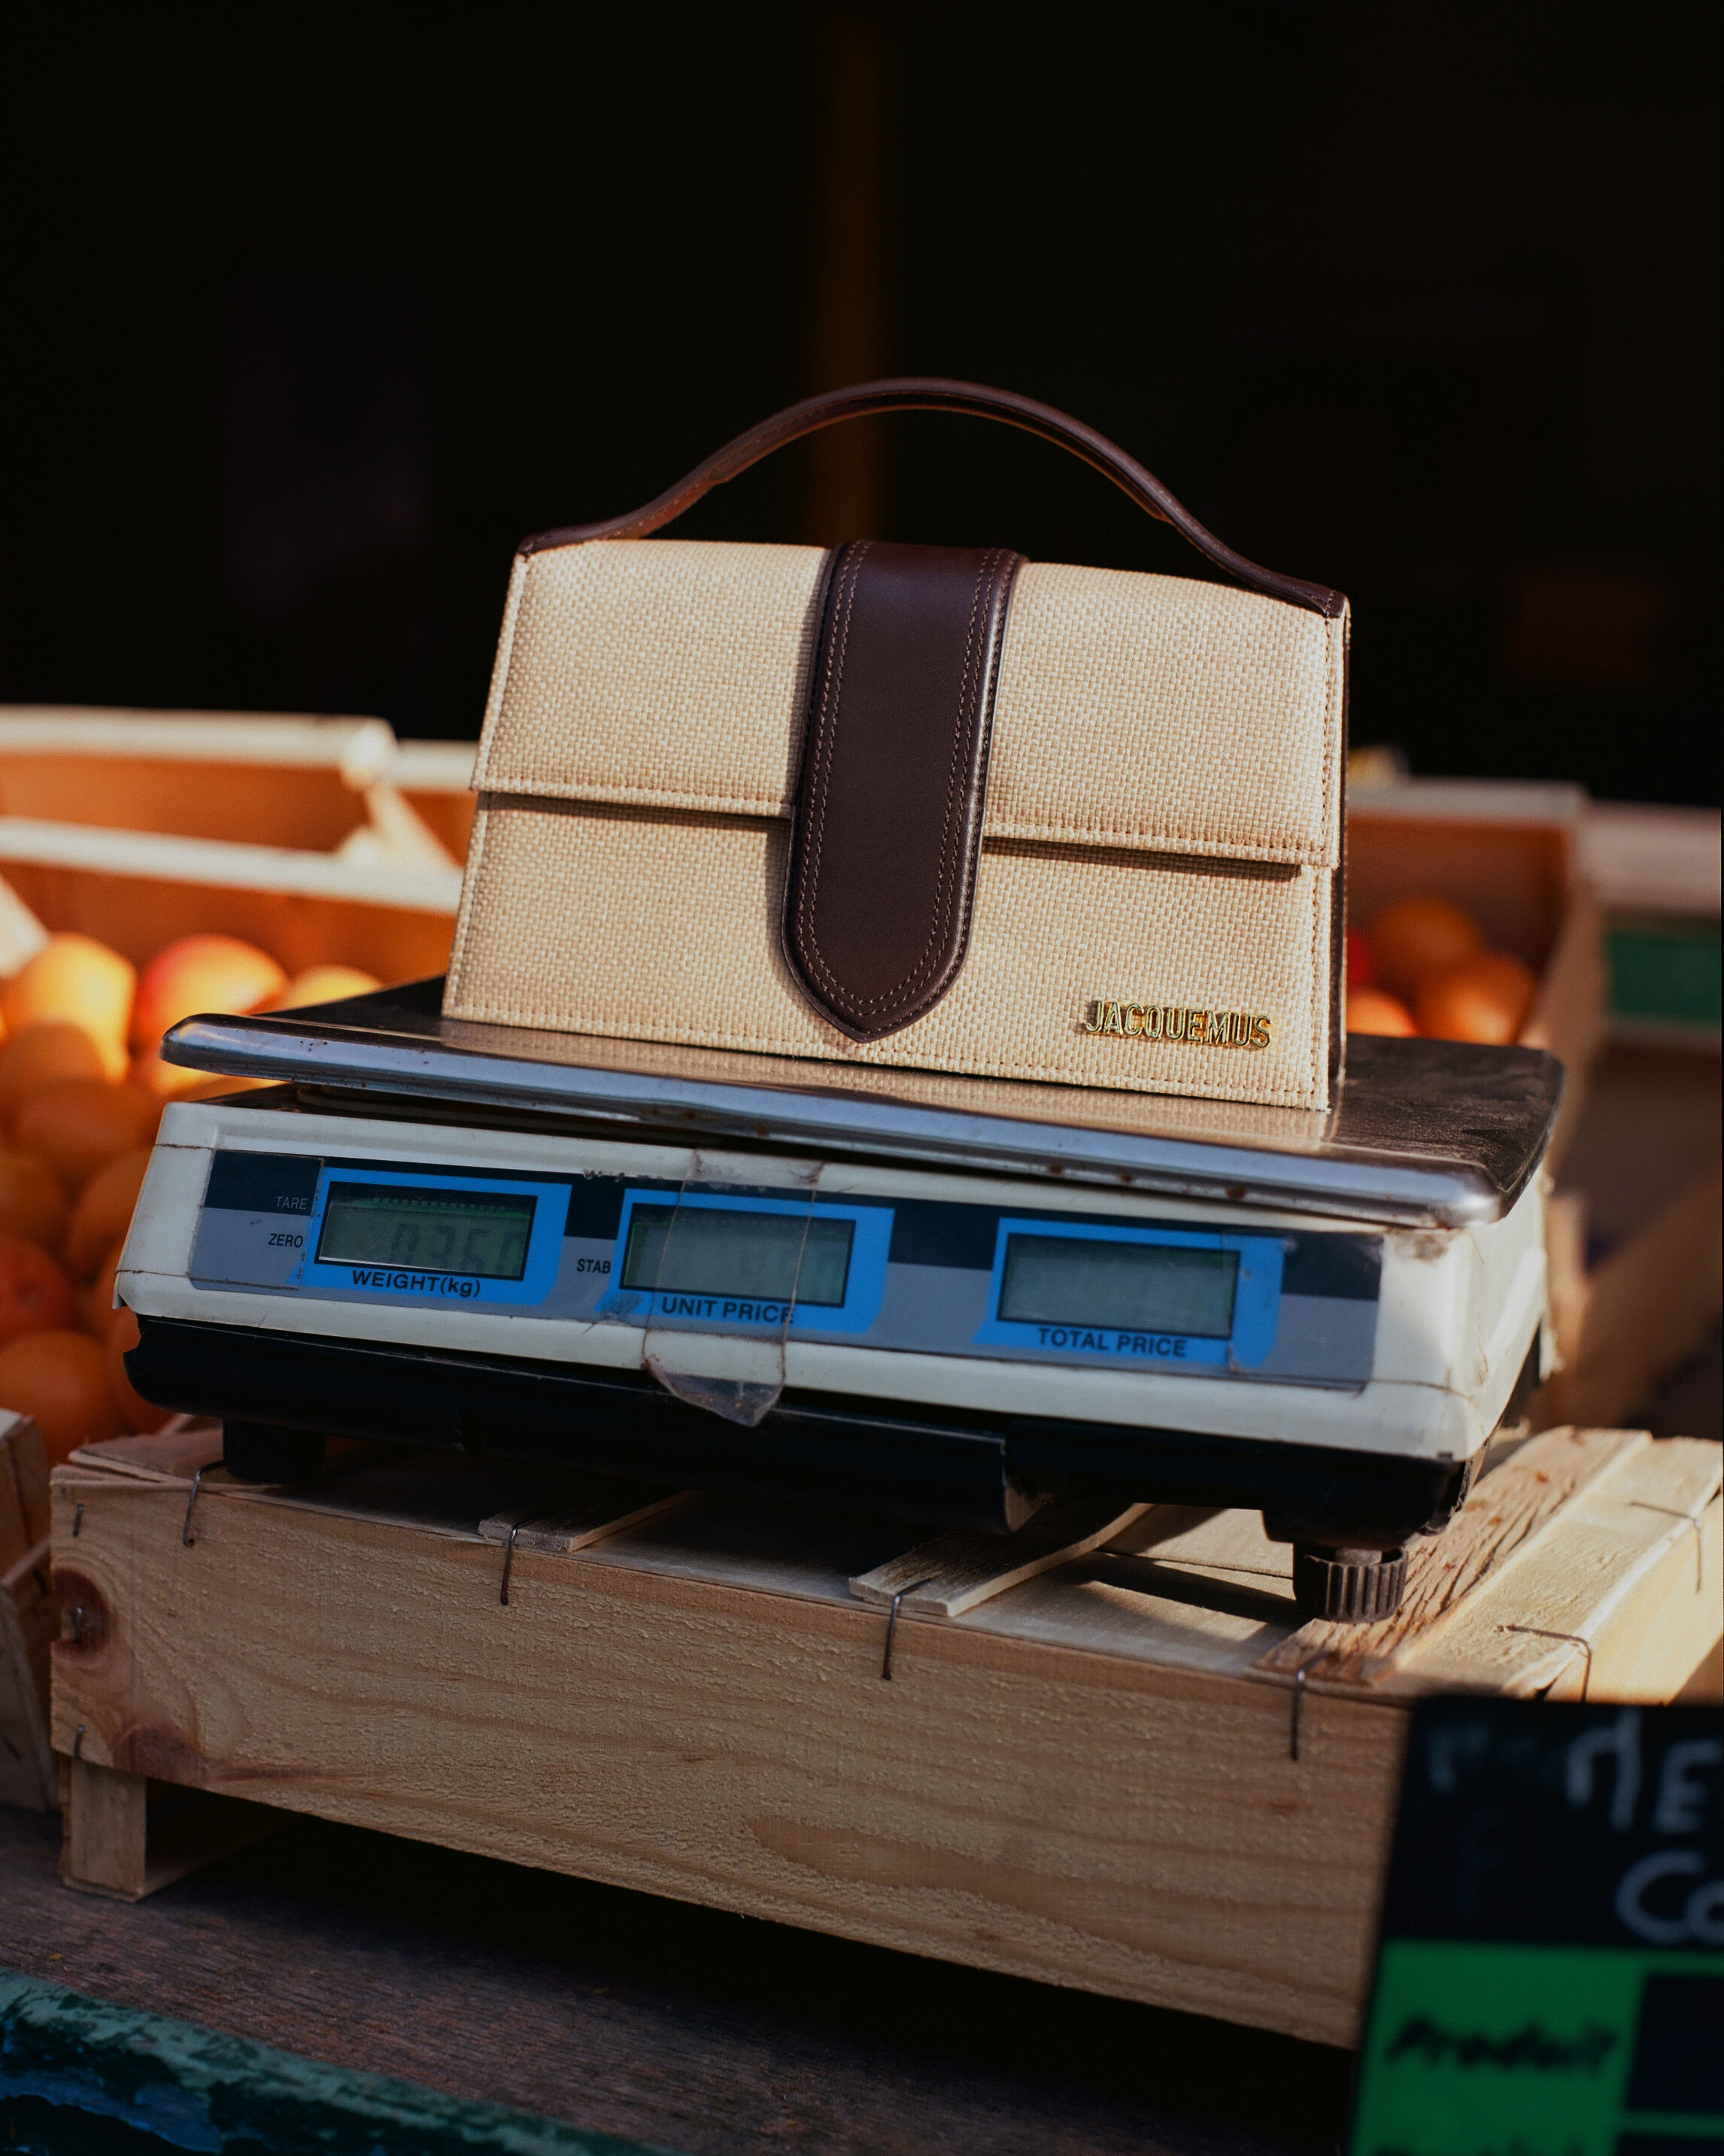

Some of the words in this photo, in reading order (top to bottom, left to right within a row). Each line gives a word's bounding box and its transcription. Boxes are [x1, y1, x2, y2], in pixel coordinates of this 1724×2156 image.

[1085, 1000, 1273, 1048] JACQUEMUS
[276, 1196, 308, 1210] TARE
[268, 1233, 304, 1249] ZERO
[577, 1258, 612, 1274] STAB
[351, 1269, 481, 1298] WEIGHT(kg)
[661, 1296, 718, 1317] UNIT
[723, 1300, 794, 1324] PRICE
[1037, 1327, 1109, 1352] TOTAL
[1116, 1334, 1188, 1357] PRICE
